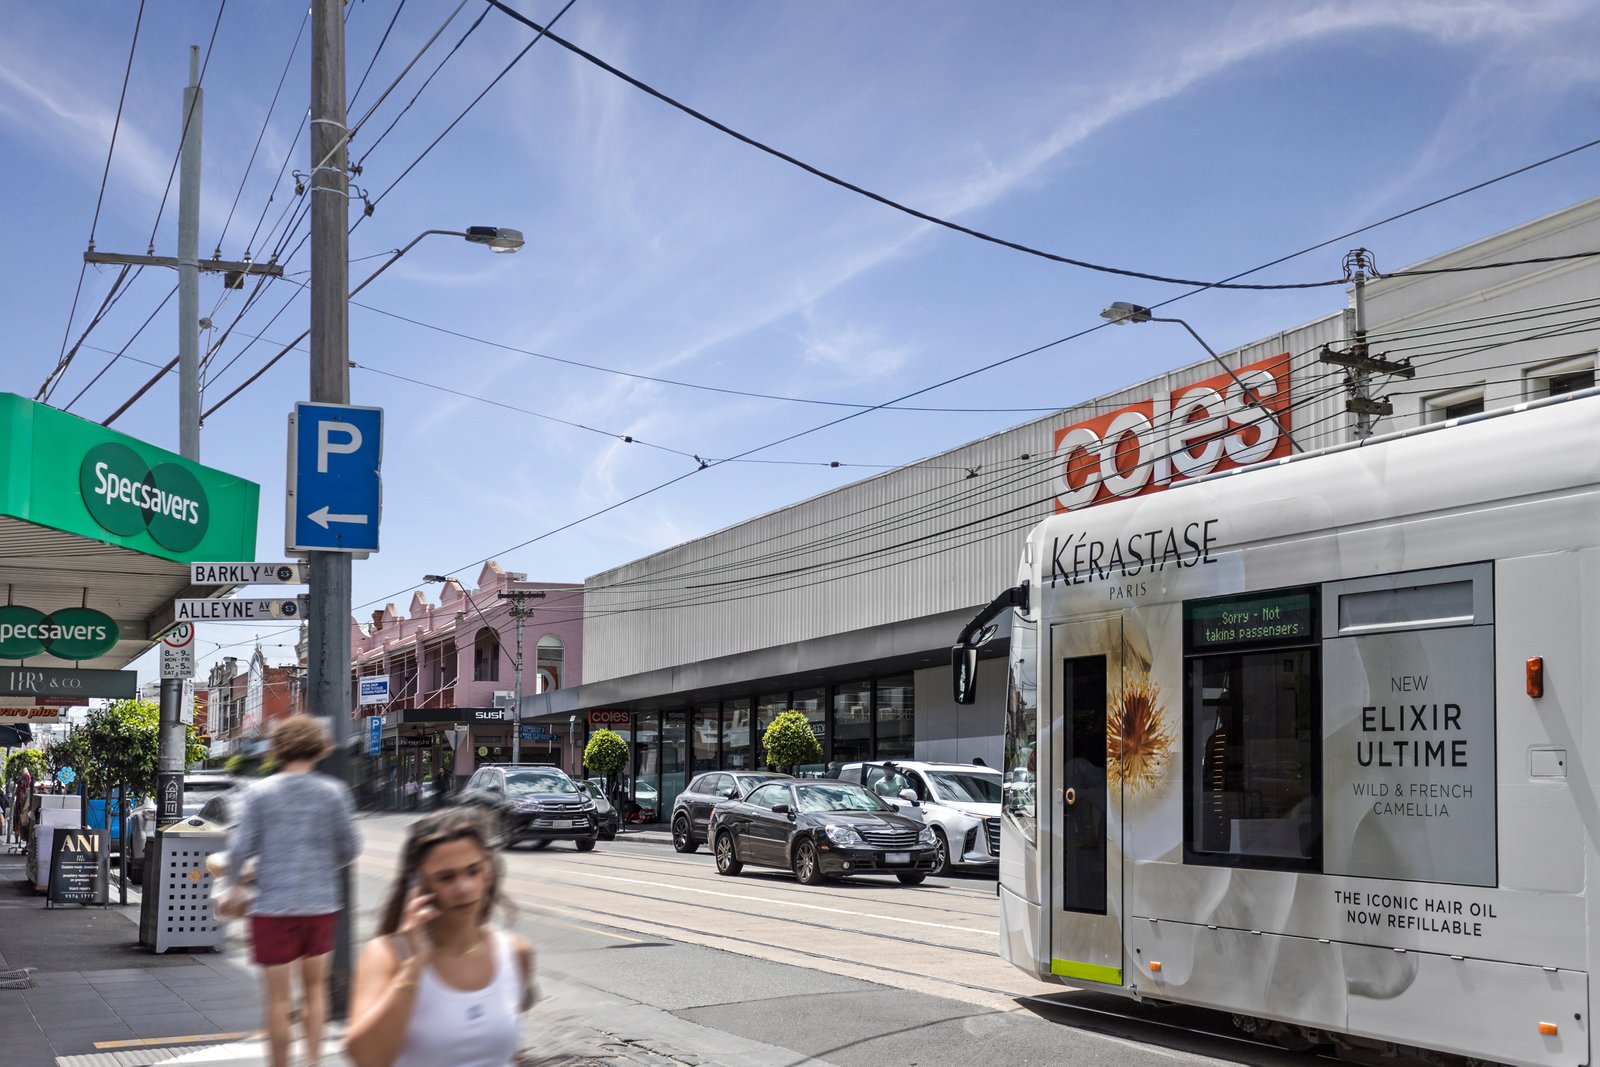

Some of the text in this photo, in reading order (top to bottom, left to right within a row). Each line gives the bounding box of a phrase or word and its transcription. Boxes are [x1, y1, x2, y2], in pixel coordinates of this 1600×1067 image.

[317, 420, 363, 473] P
[1053, 370, 1280, 511] coles
[94, 461, 199, 525] Specsavers
[1051, 518, 1219, 588] KÉRASTASE
[195, 566, 260, 582] BARKLY
[263, 566, 275, 575] AV
[1109, 582, 1147, 600] PARIS
[179, 602, 254, 619] ALLEYNE
[258, 602, 270, 611] AV
[1222, 611, 1249, 625] Sorry
[1262, 606, 1280, 620] Not
[0, 623, 107, 643] pecsavers
[1205, 623, 1299, 642] taking passengers
[49, 678, 58, 688] &
[1391, 675, 1428, 692] NEW
[28, 706, 58, 718] plus
[475, 710, 505, 719] sush
[591, 711, 629, 722] coles
[1362, 703, 1462, 732] ELIXIR
[372, 719, 380, 729] P
[1357, 740, 1468, 767] ULTIME
[1352, 783, 1473, 799] WILD & FRENCH
[1373, 801, 1450, 817] CAMELLIA
[60, 834, 99, 852] ANI
[1334, 891, 1497, 918] THE ICONIC HAIR OIL
[1347, 910, 1482, 937] NOW REFILLABLE
